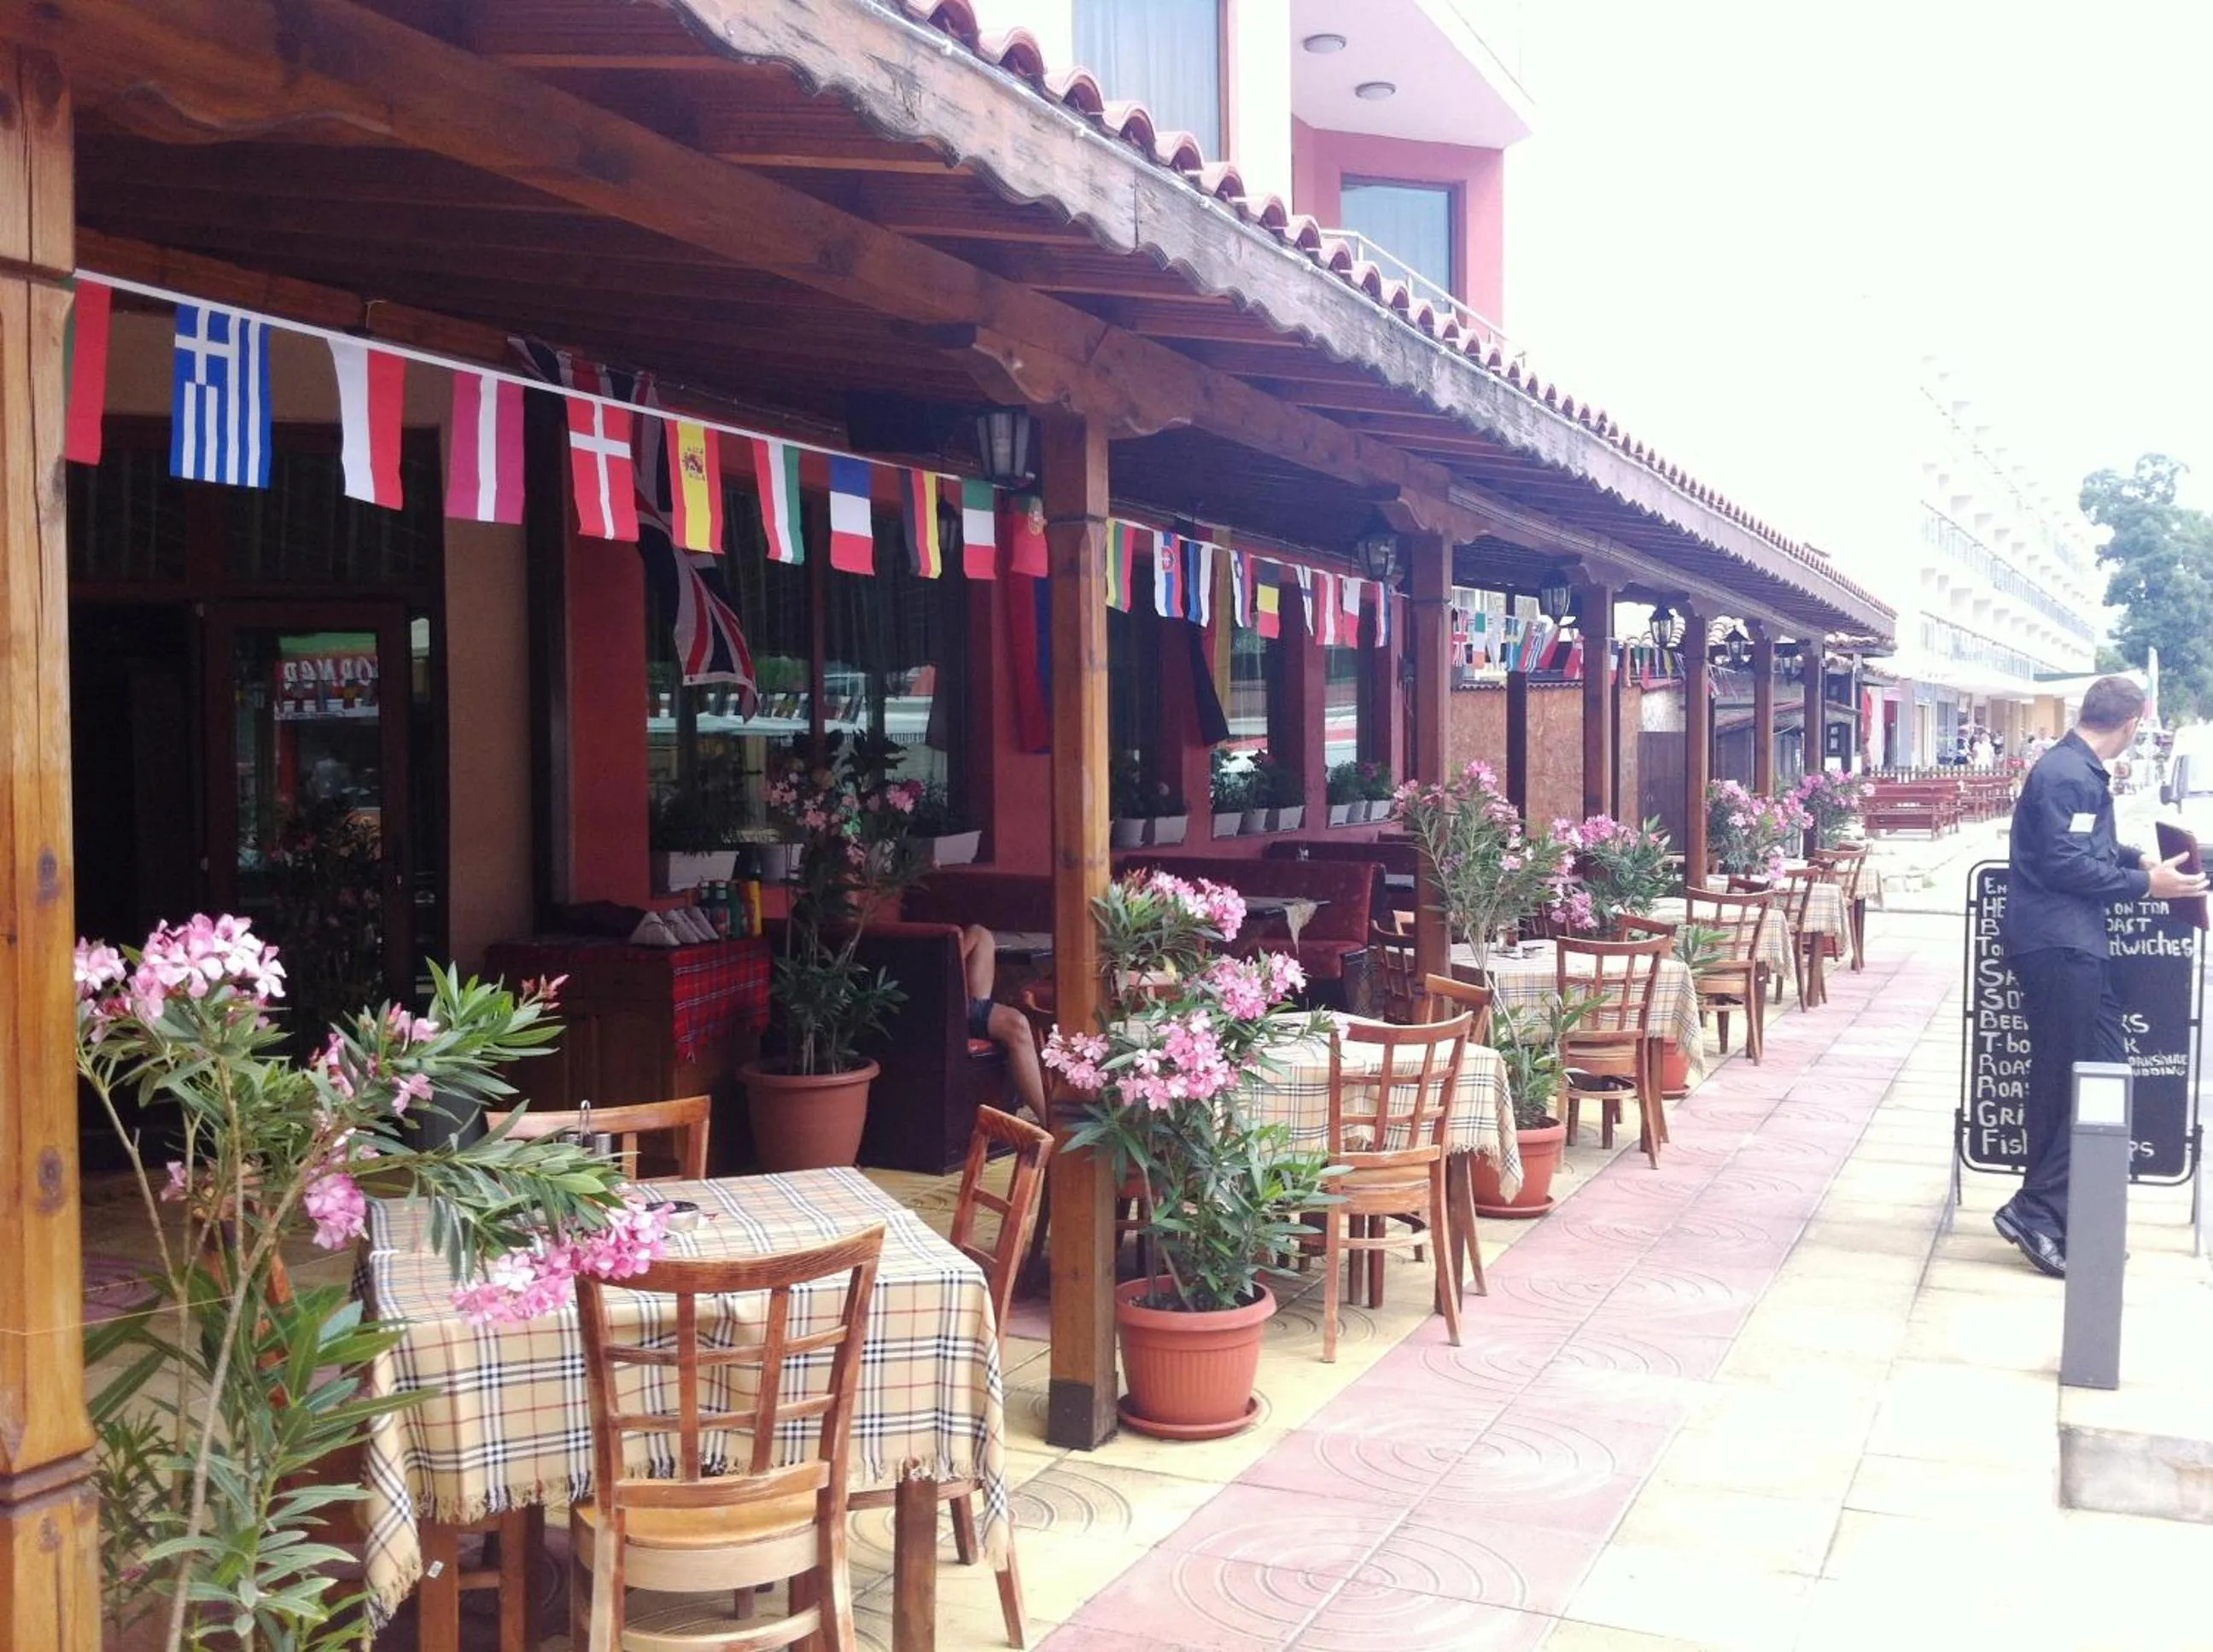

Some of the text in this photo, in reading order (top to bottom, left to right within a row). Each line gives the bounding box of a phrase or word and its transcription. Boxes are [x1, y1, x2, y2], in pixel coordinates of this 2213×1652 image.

[2137, 901, 2169, 915] TOA
[1979, 1010, 2029, 1030] BEE
[1979, 1030, 2031, 1054] T-bo
[2132, 1066, 2186, 1077] UDDING
